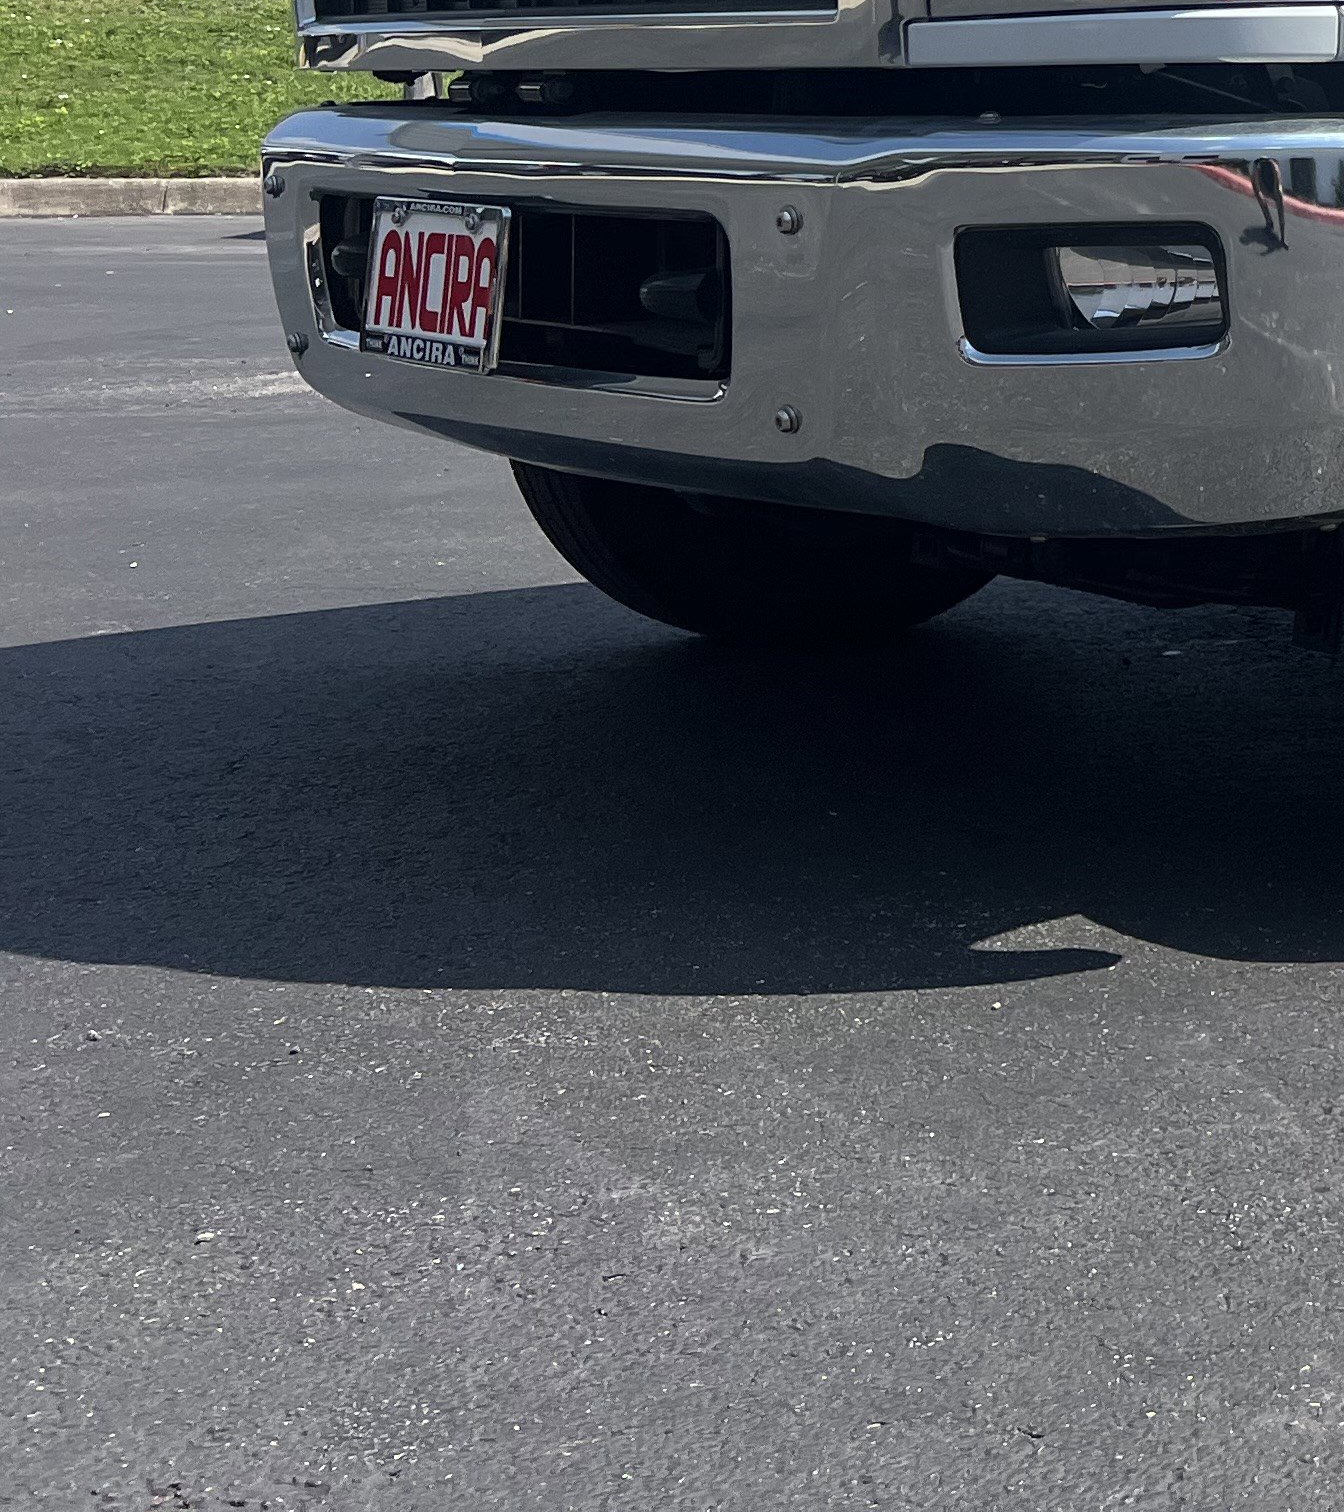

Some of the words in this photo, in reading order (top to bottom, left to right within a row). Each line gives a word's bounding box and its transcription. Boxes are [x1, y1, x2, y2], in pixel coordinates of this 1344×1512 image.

[409, 202, 463, 216] ANCIRA.COM
[374, 229, 497, 340] ANCIRA
[387, 336, 456, 366] ANCIRA
